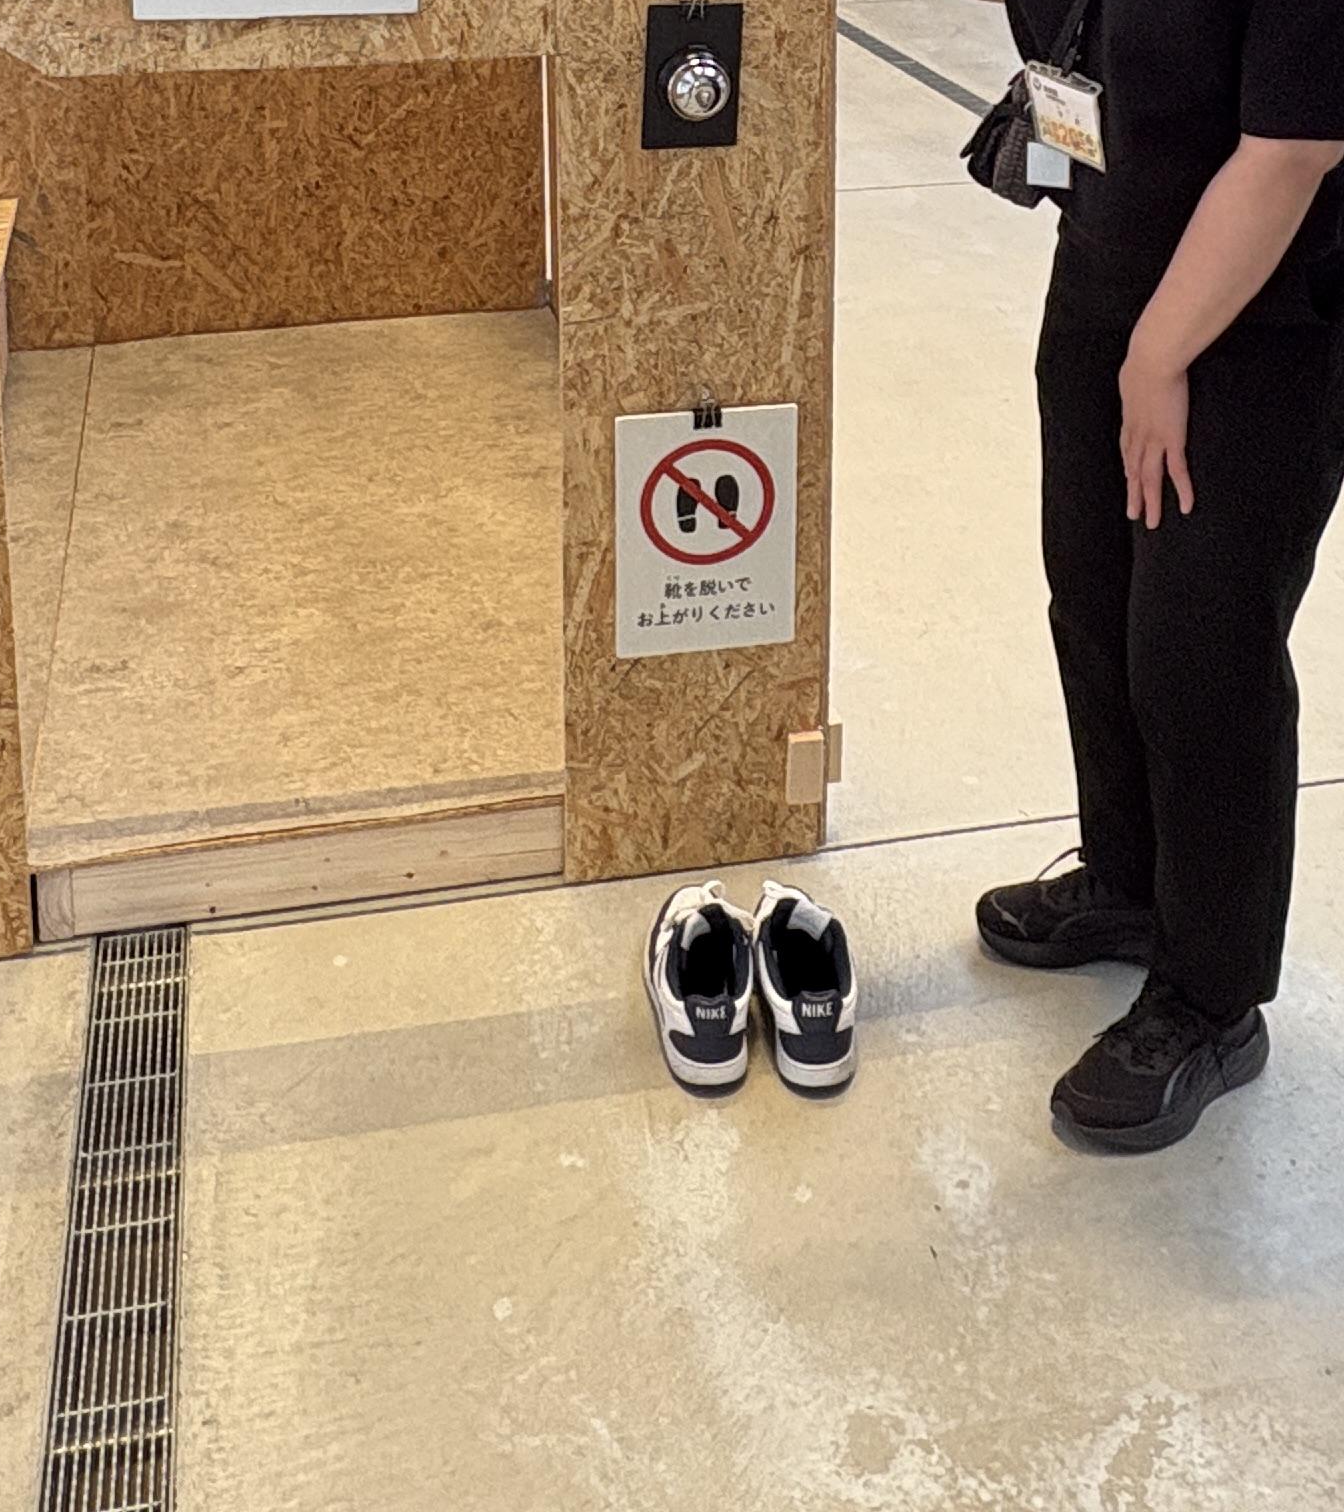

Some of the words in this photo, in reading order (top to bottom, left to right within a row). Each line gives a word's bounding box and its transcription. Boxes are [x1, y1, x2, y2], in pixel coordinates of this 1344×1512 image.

[664, 576, 753, 599] 靴を脱いで
[636, 602, 776, 628] お上がりください
[695, 1005, 727, 1021] NIKE
[801, 1001, 834, 1018] NIKE
